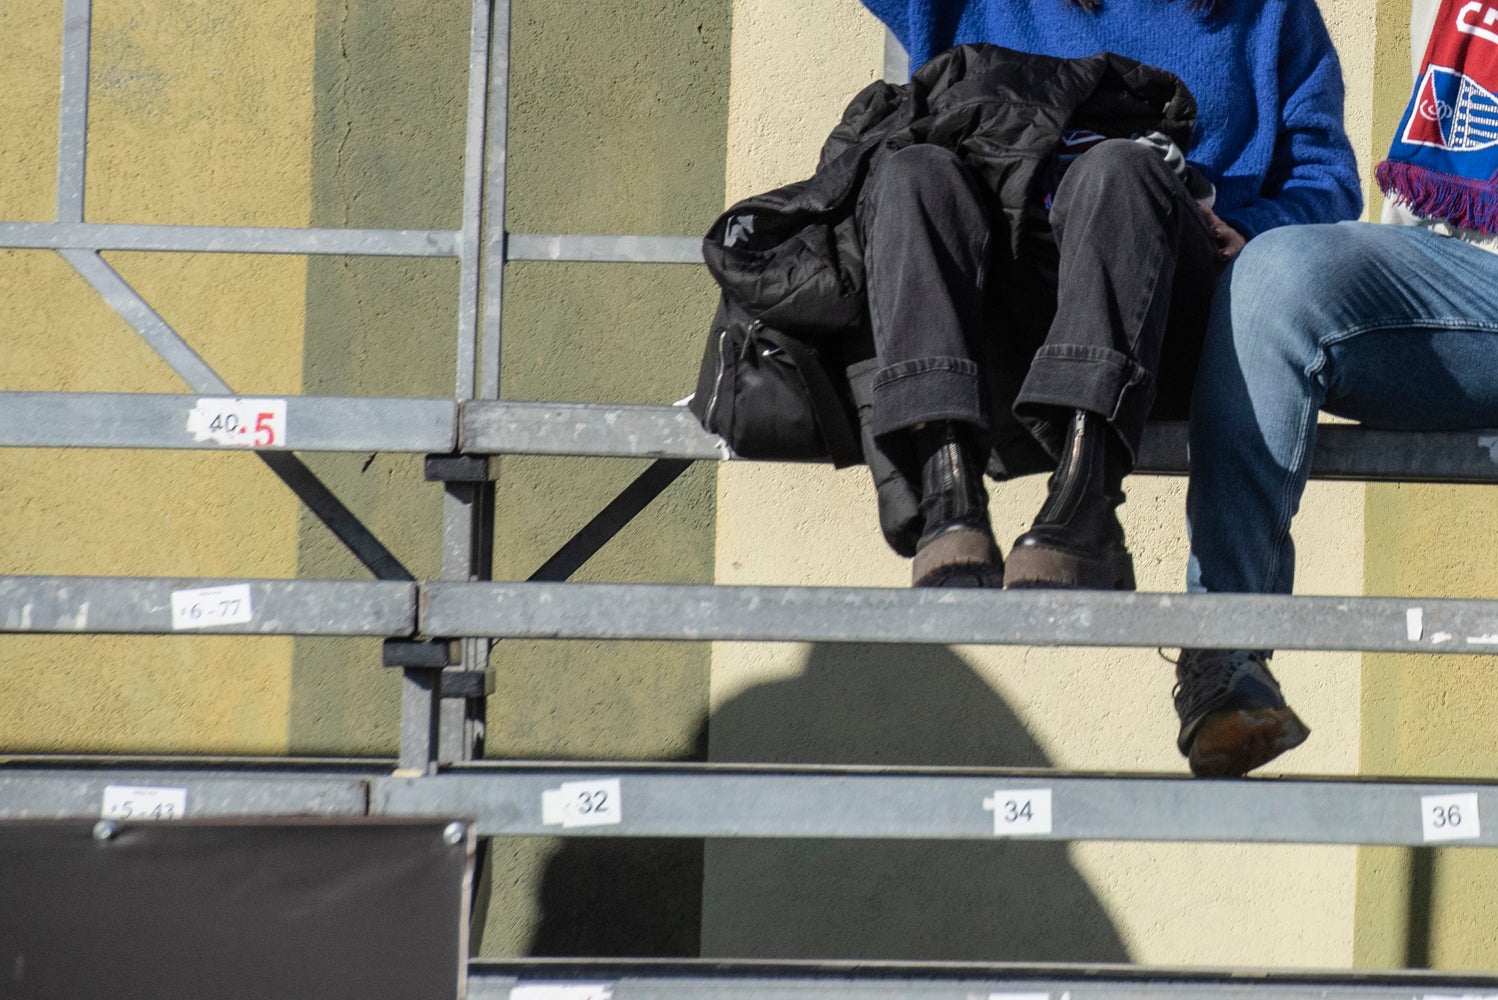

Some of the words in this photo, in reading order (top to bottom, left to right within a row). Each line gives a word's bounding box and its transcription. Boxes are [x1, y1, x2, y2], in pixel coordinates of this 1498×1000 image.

[577, 790, 609, 814] 32
[1004, 799, 1033, 822] 34
[1432, 804, 1461, 828] 36
